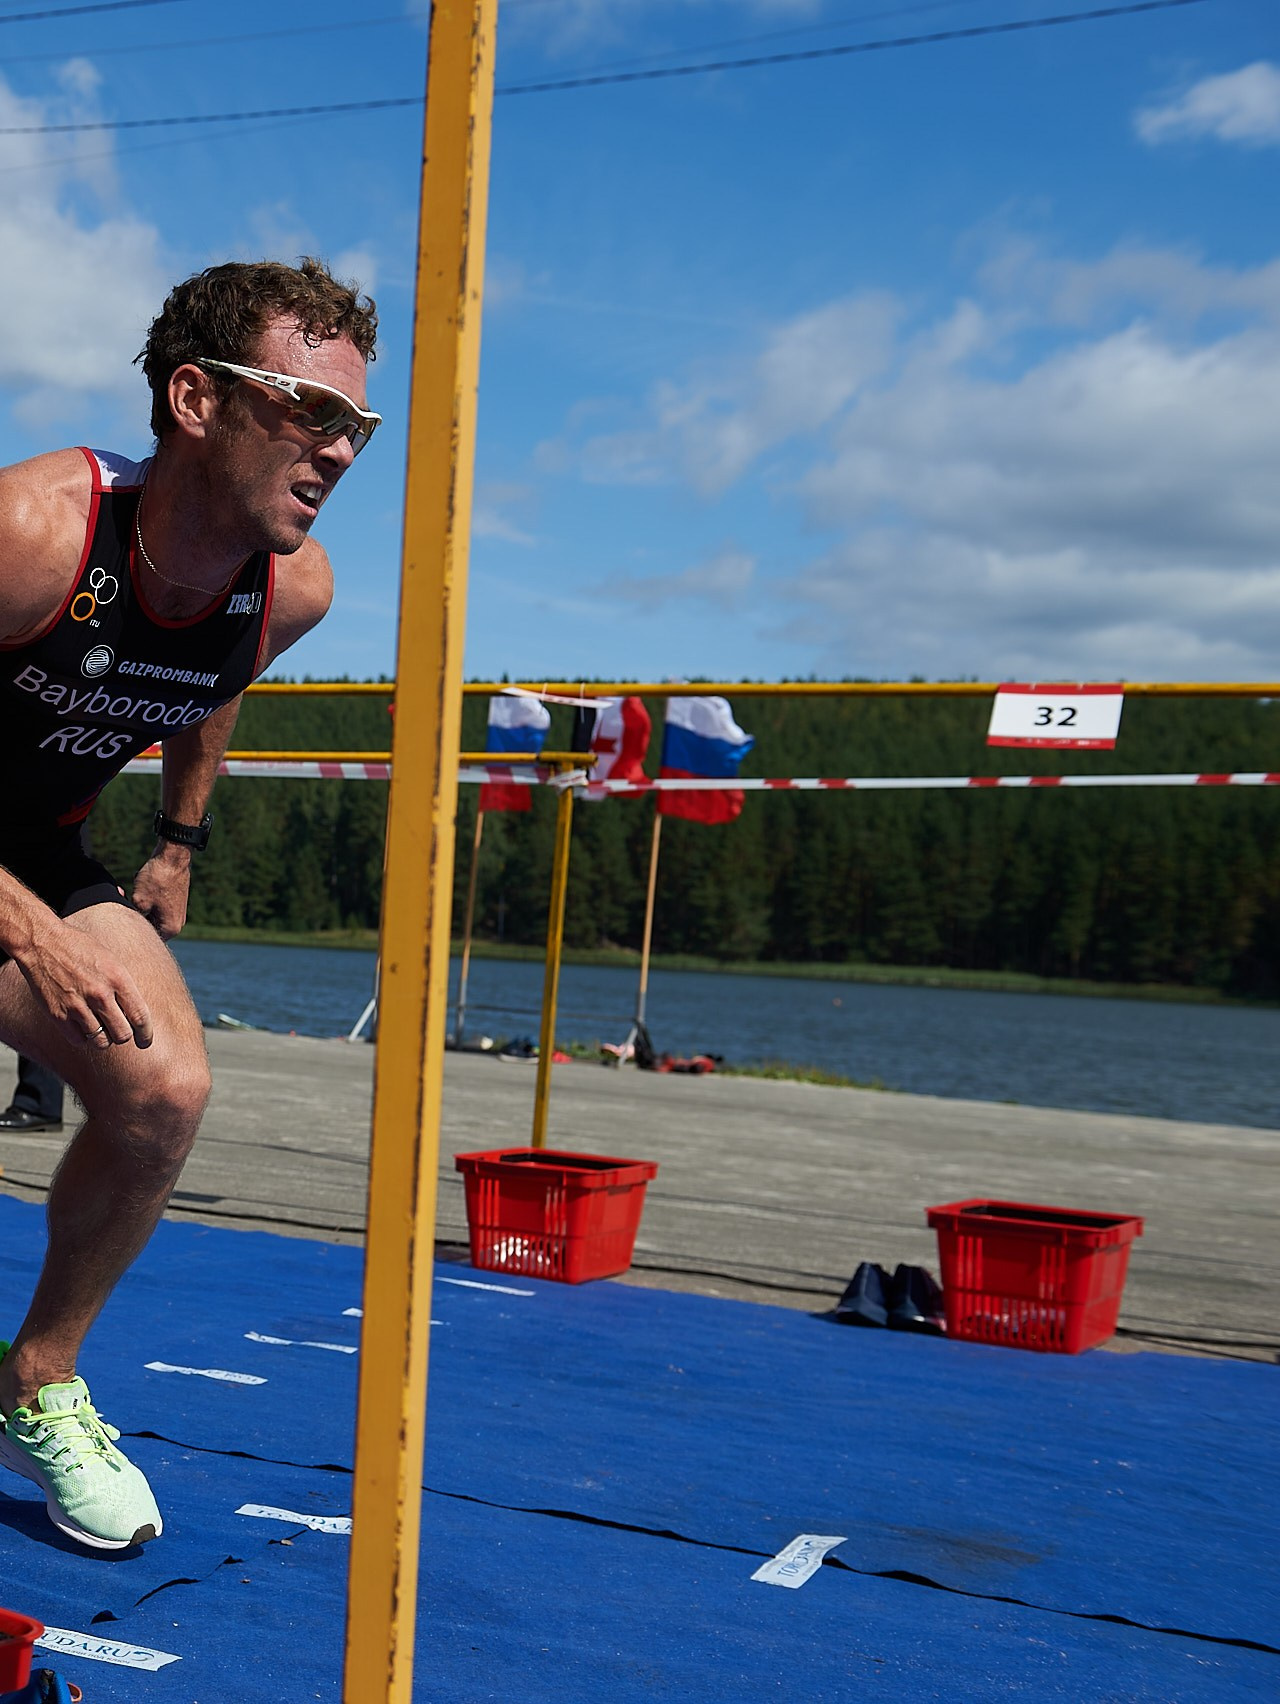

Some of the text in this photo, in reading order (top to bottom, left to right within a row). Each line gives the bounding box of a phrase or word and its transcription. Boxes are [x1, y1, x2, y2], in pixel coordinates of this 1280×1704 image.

[118, 661, 220, 687] GAZPROMBANK
[1033, 706, 1077, 726] 32
[39, 726, 133, 758] RUS
[41, 1633, 131, 1658] UDA.RU
